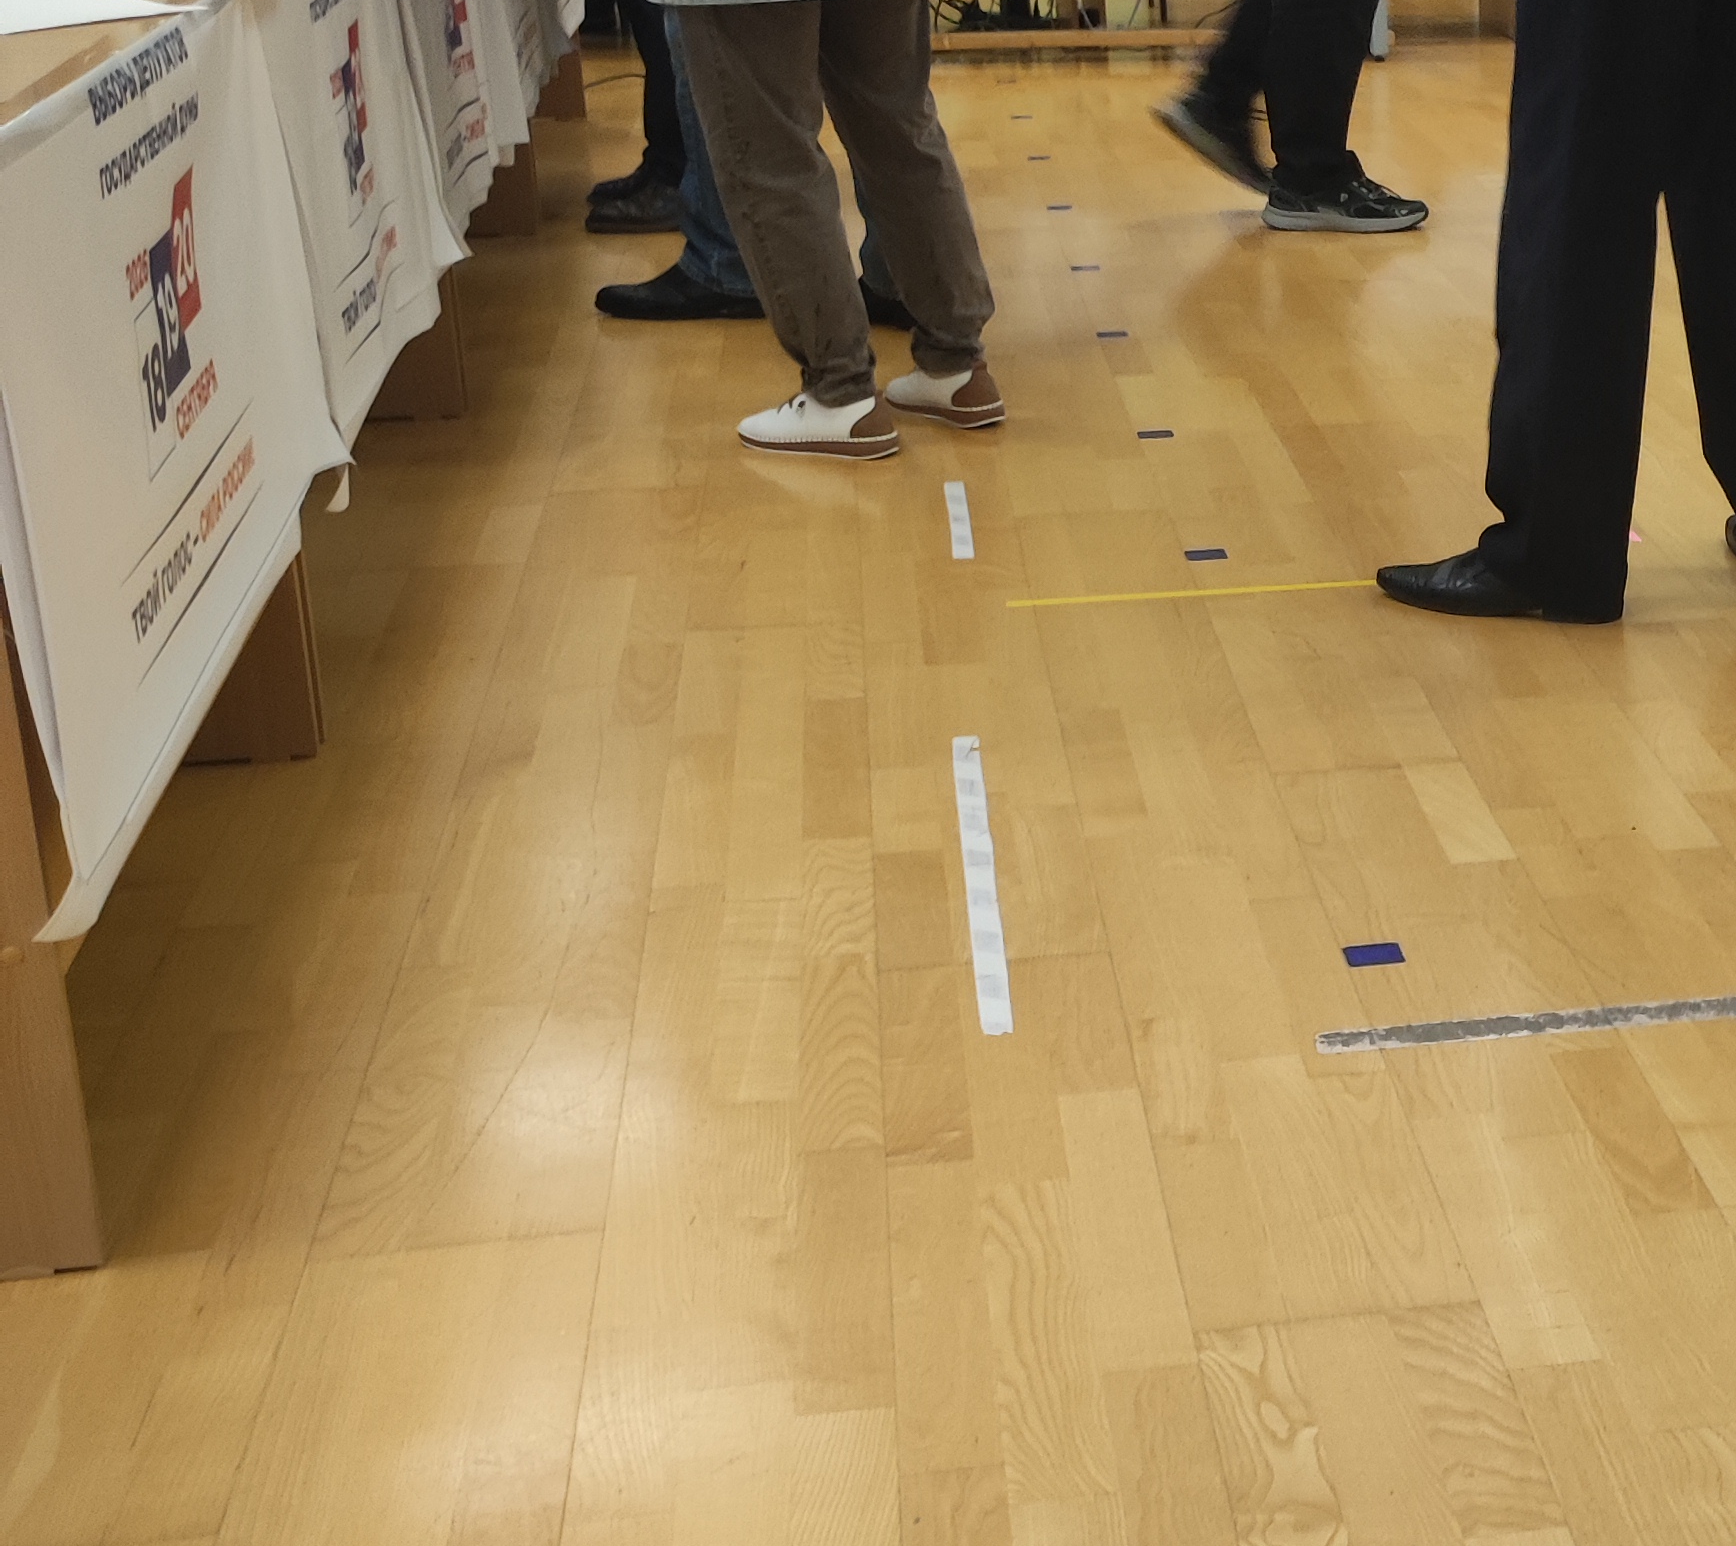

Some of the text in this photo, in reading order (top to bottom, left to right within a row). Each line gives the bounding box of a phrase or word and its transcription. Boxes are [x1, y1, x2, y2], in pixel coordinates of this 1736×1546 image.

[88, 61, 139, 127] ВЫБОРЫ
[100, 102, 180, 199] ГОСУДАРСТВЕННОЙ
[172, 206, 197, 299] 20
[158, 271, 181, 360] 19
[142, 342, 167, 434] 18
[132, 567, 162, 644] ТВОЙ
[160, 531, 193, 603] ГОЛОС
